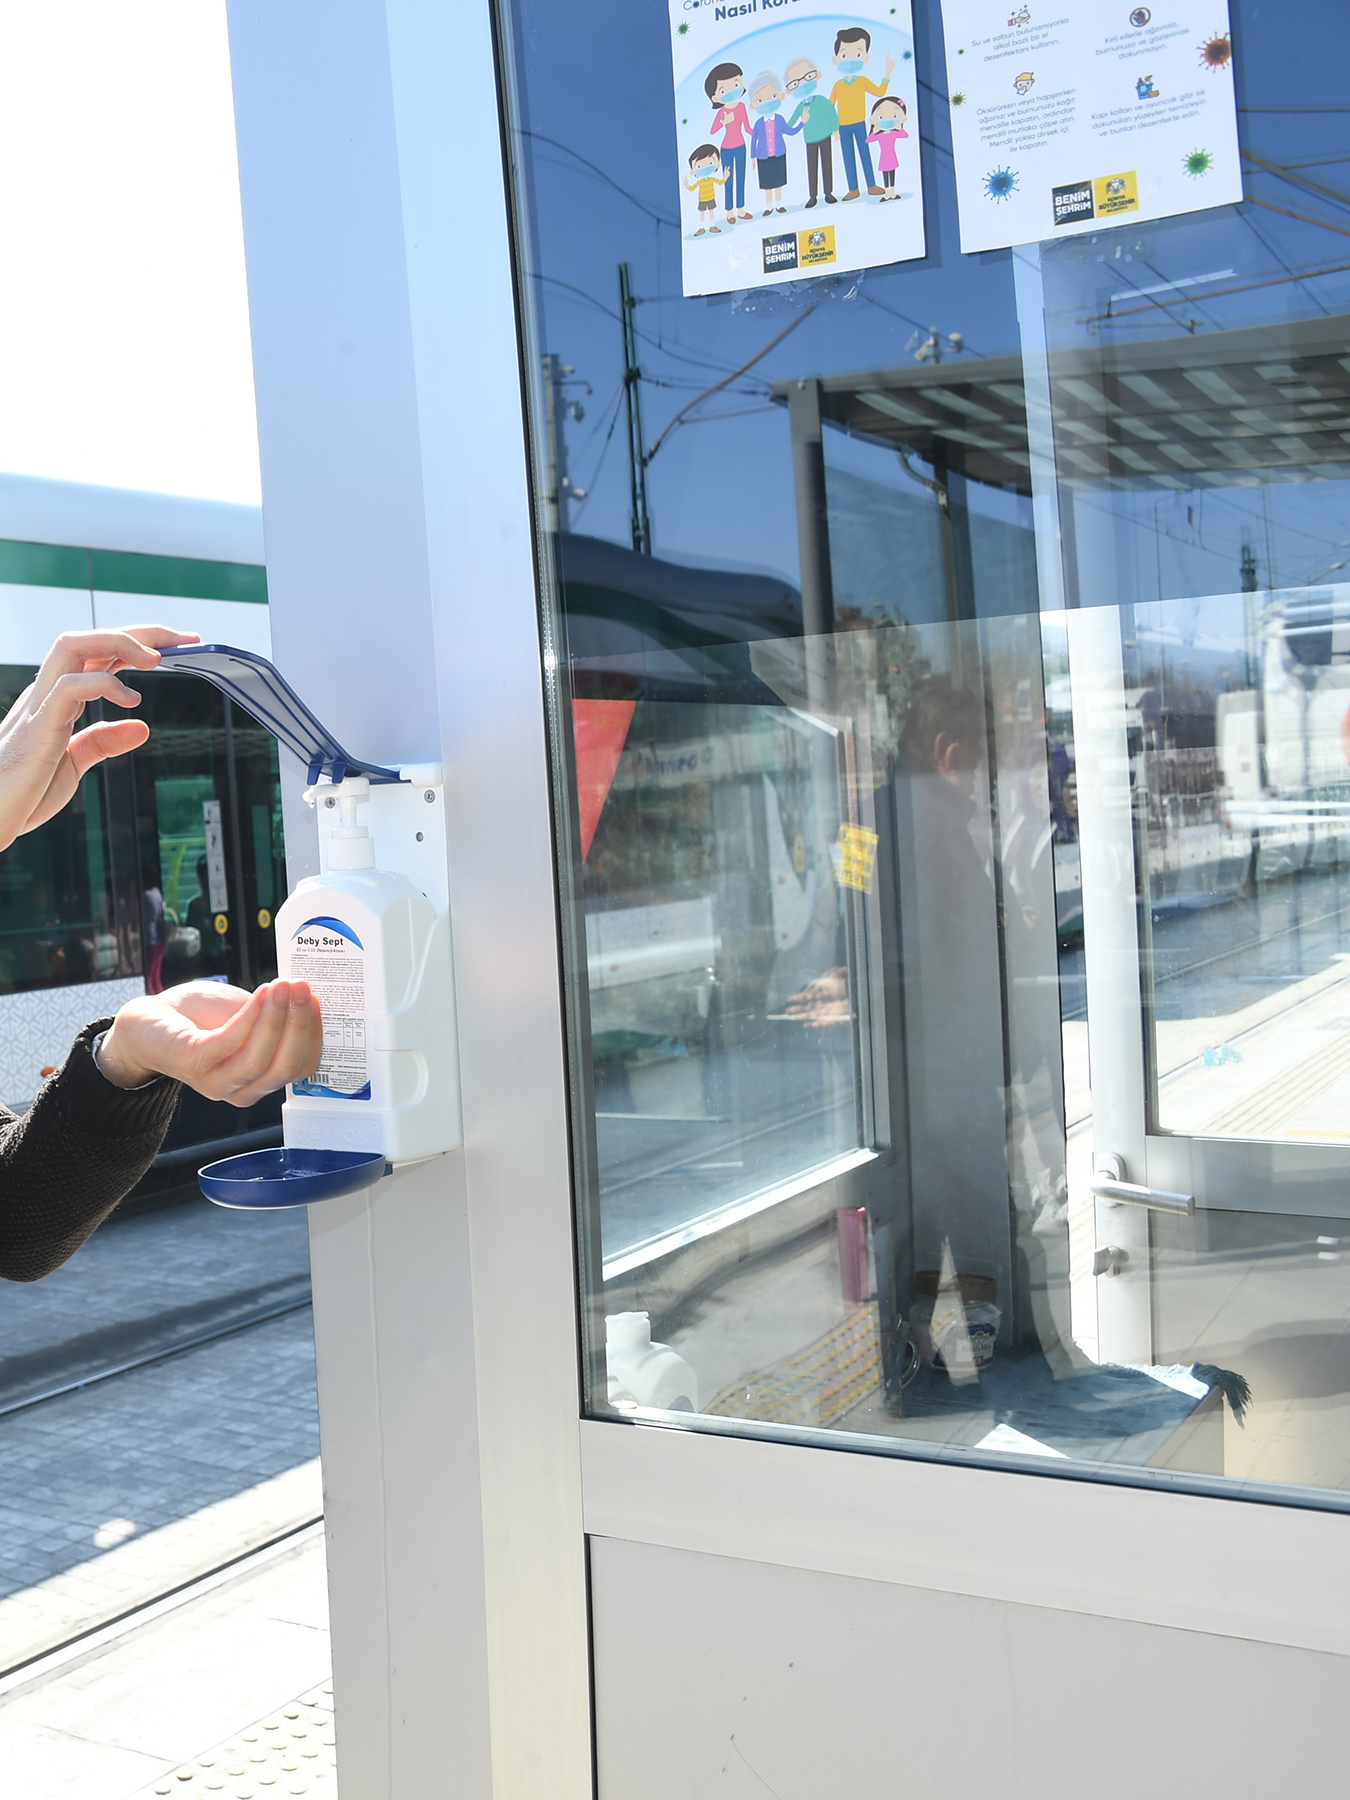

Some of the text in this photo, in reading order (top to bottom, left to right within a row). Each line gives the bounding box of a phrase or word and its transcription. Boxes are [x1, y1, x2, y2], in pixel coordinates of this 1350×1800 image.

[714, 0, 757, 21] Nasıl
[992, 32, 1015, 42] sabun
[993, 41, 1010, 50] alkol
[1041, 31, 1049, 39] el
[1018, 98, 1035, 106] veya
[1007, 124, 1037, 135] mutlaka
[1039, 119, 1058, 129] çöpe
[1014, 134, 1035, 143] yoksa
[1055, 189, 1090, 206] BENİM
[1056, 200, 1091, 216] ŞEHRİM
[765, 241, 795, 255] BENİM
[765, 251, 796, 265] ŞEHRİM
[297, 936, 344, 947] Deby Sept
